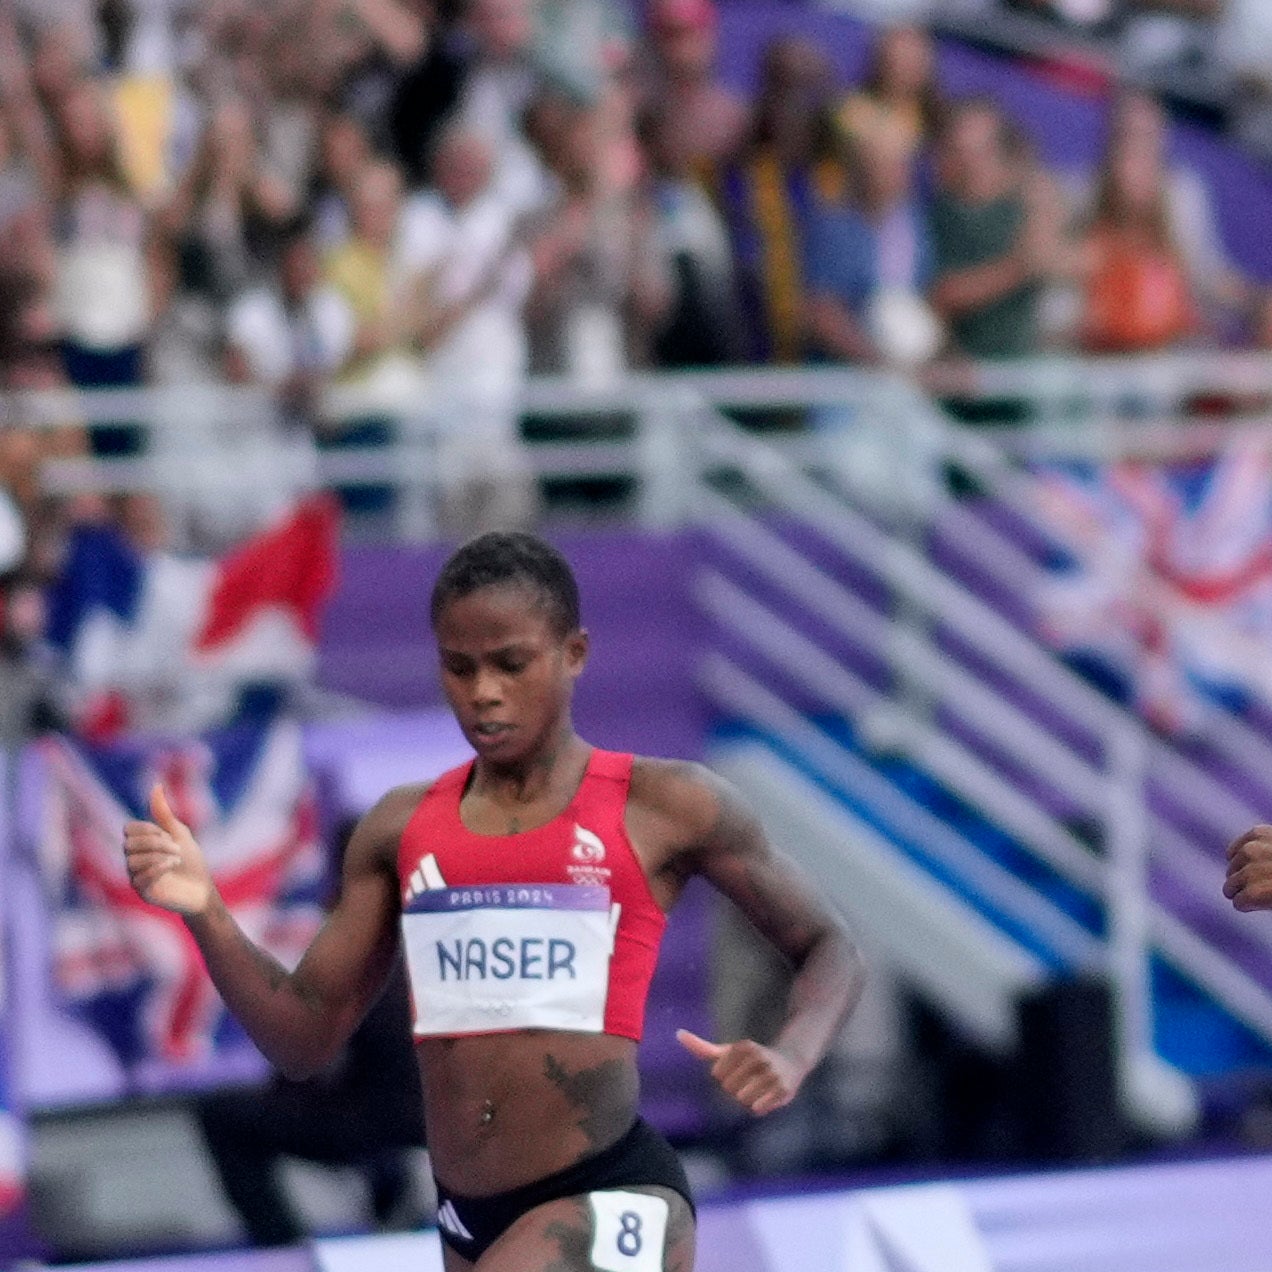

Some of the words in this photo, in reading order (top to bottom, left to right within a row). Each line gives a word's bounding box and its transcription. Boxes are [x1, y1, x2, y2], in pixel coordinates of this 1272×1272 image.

[451, 889, 502, 905] PARIS
[507, 888, 553, 904] 2024
[435, 936, 577, 982] NASER
[617, 1210, 642, 1257] 8
